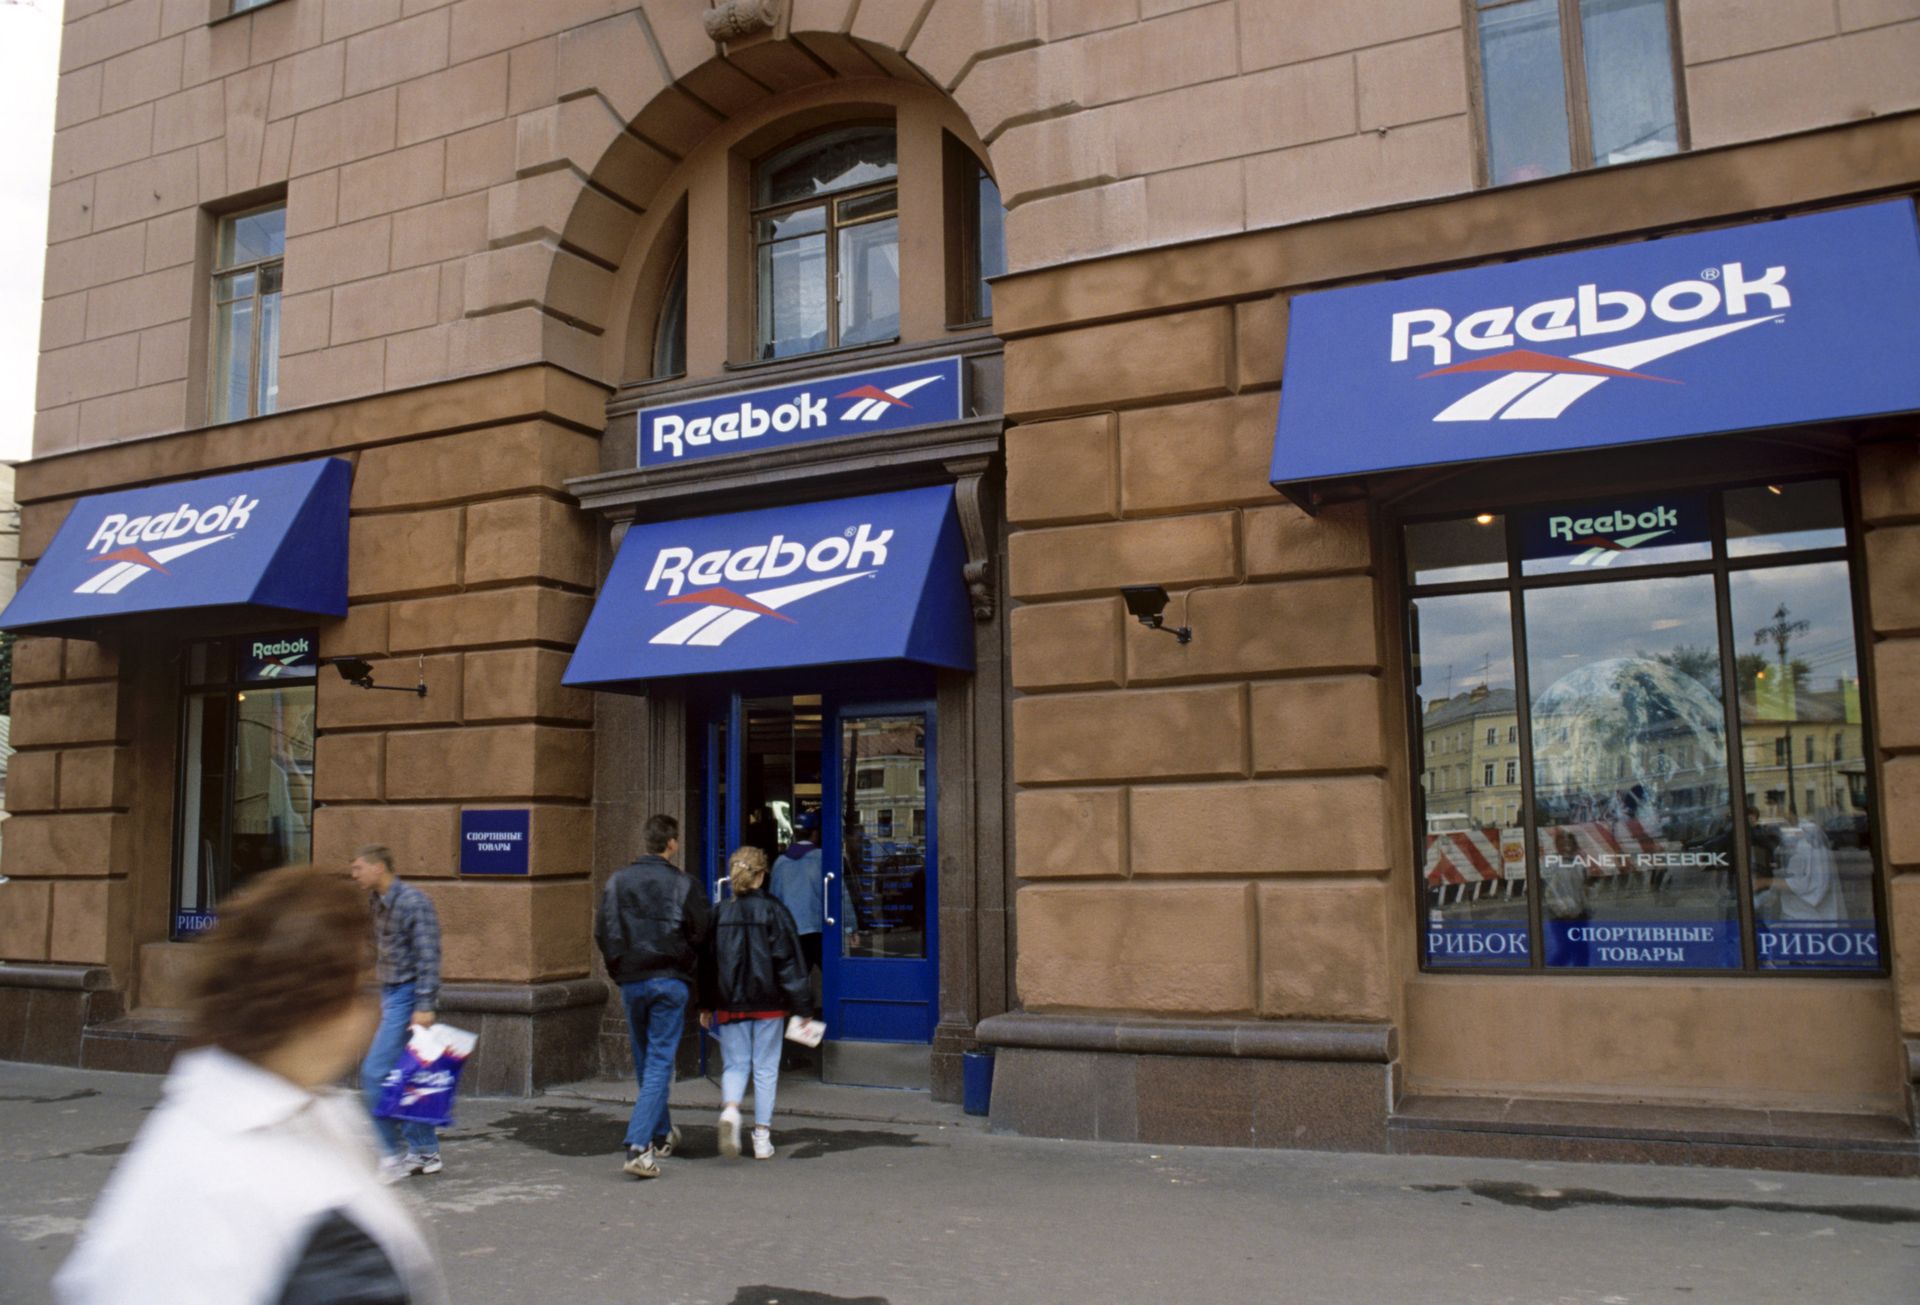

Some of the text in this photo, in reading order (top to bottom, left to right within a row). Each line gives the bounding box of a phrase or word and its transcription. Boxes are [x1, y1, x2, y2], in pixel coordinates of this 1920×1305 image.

[1390, 262, 1791, 366] Reebok
[653, 392, 828, 457] Reebok
[86, 494, 259, 554] Reebok
[1549, 505, 1678, 541] Reebok
[644, 523, 894, 596] Reebok
[252, 637, 309, 660] Reebok
[466, 831, 523, 841] СПОРТИВНЫЕ
[477, 842, 511, 852] ТОВАРЫ
[1544, 851, 1729, 868] PLANET REEBOK
[1427, 932, 1528, 955] РИБОК
[1567, 926, 1714, 942] СПОРТИВНЫЕ
[1759, 933, 1877, 956] РИБОК
[1597, 946, 1684, 962] ТОВАРЫ
